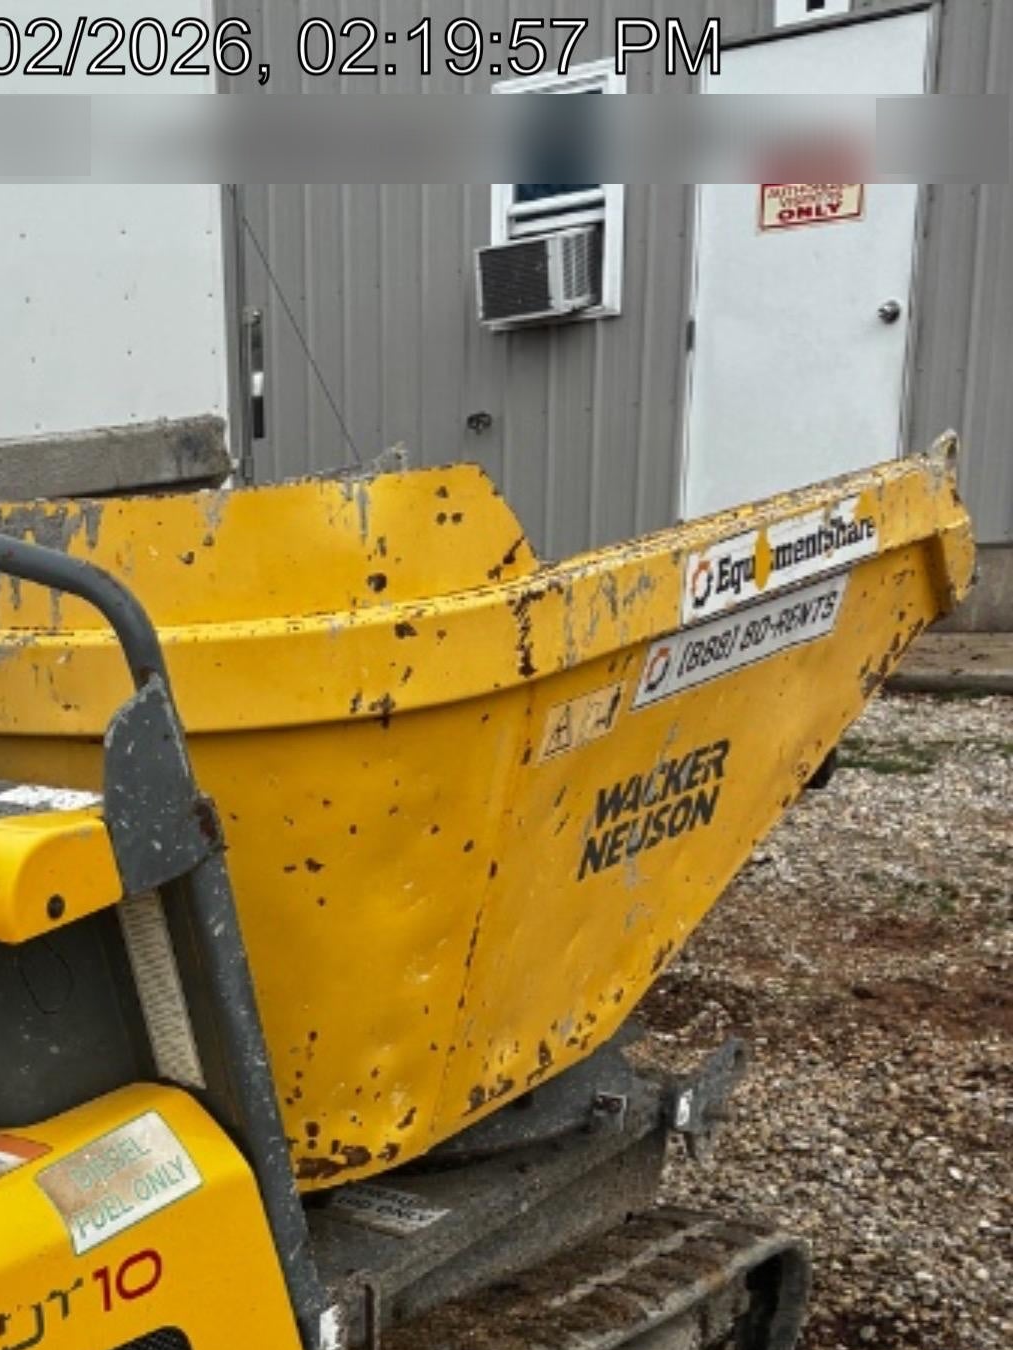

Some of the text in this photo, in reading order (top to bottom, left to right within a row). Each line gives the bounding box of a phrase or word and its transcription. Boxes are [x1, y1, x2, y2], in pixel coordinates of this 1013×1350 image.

[716, 515, 876, 594] EqumentShare
[595, 737, 730, 829] WACKER
[578, 785, 719, 882] NEUSON
[71, 1136, 151, 1191] DIESEL
[73, 1155, 188, 1239] FUEL ONLY
